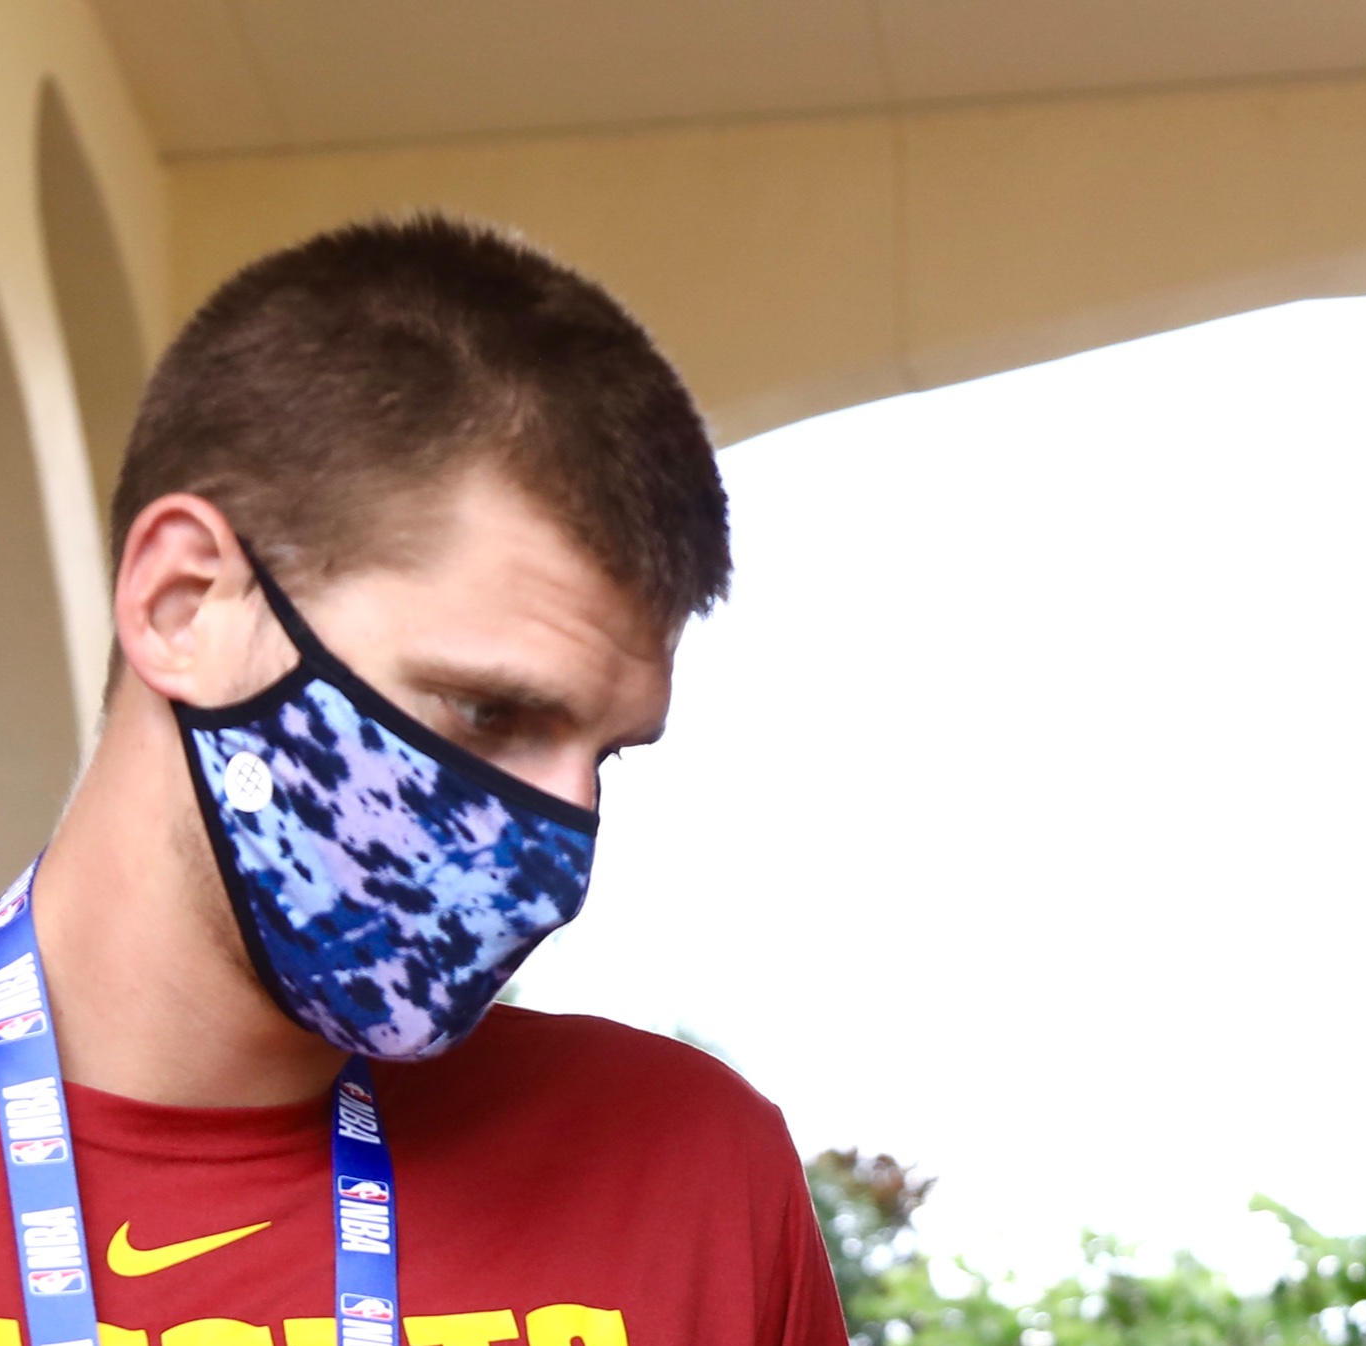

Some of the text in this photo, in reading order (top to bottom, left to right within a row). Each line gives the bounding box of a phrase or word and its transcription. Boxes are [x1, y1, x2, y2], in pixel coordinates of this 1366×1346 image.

[2, 1076, 65, 1140] NBA
[338, 1089, 382, 1145] NBA
[21, 1205, 82, 1269] NBA
[339, 1199, 391, 1255] NBA
